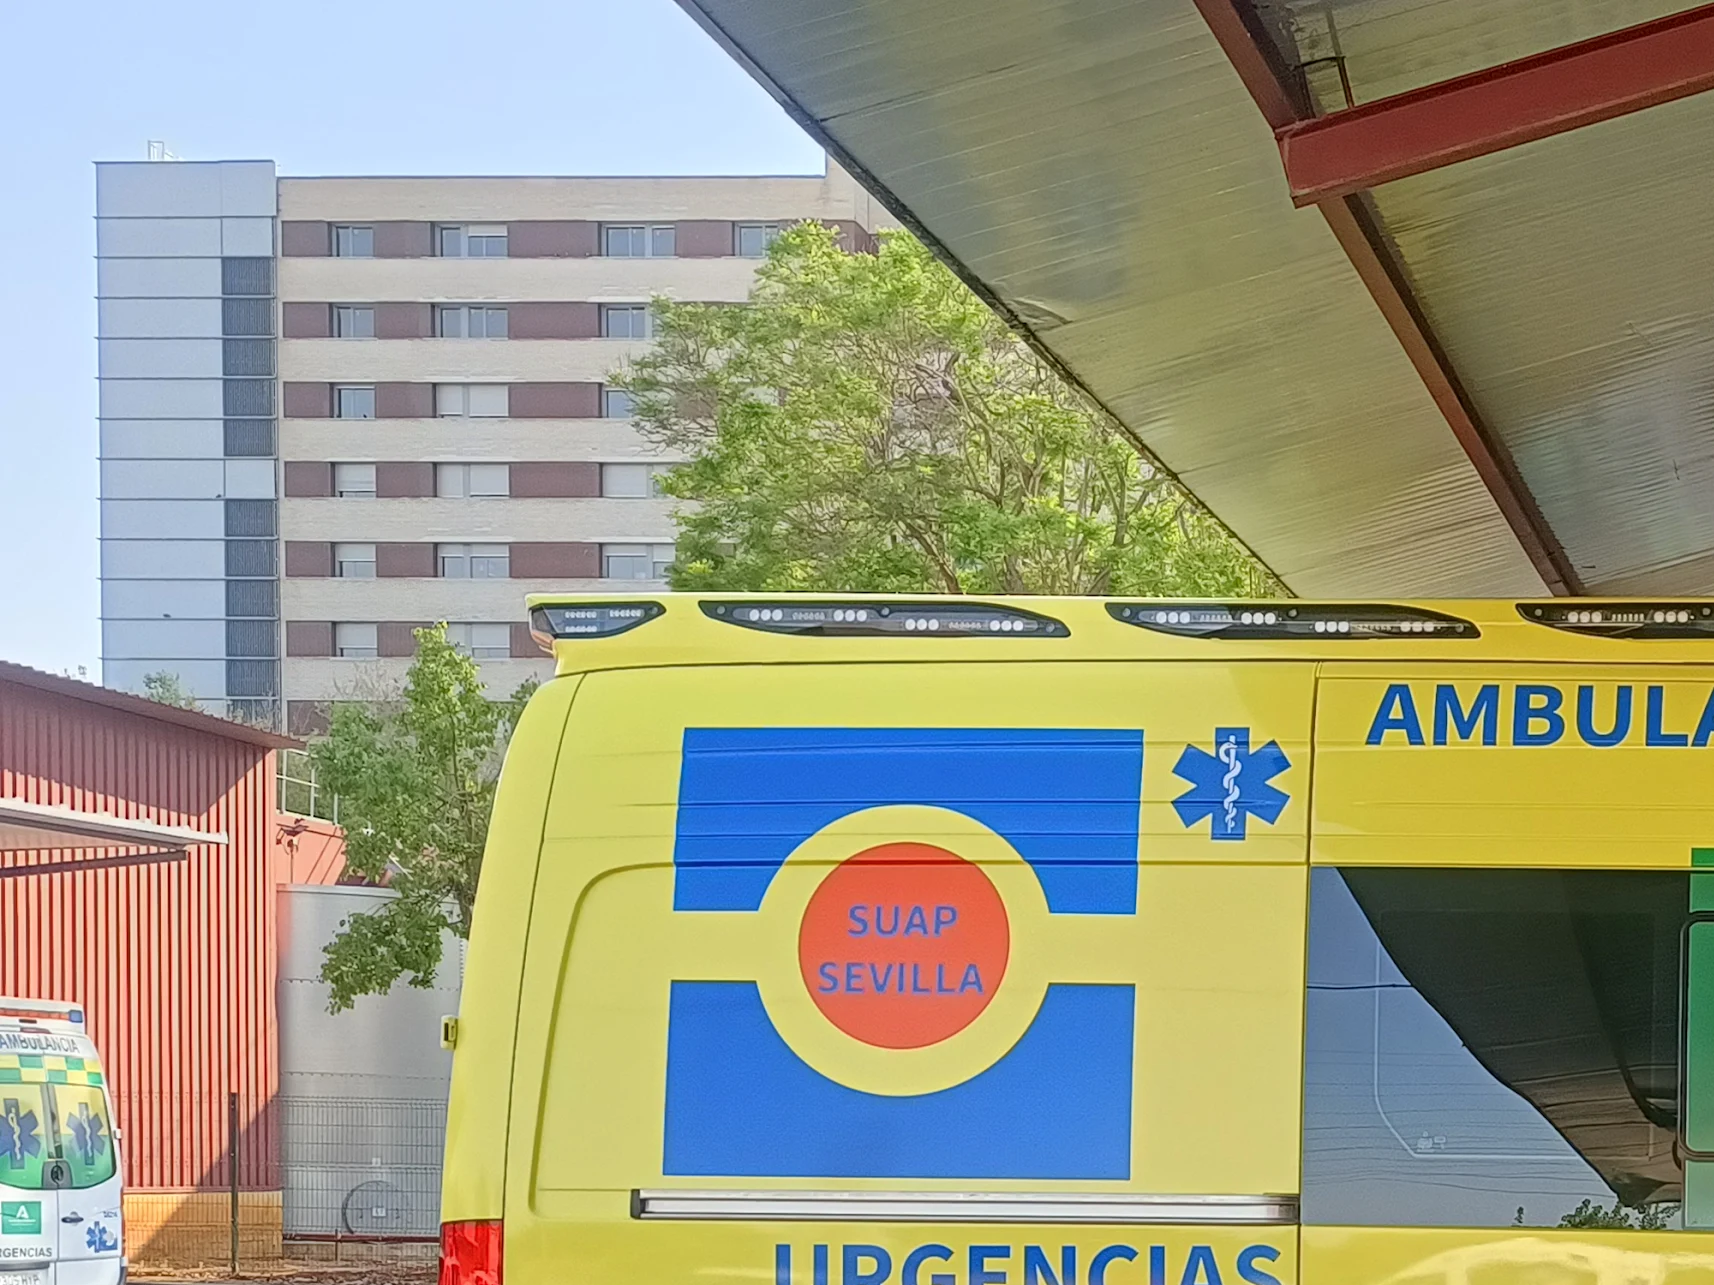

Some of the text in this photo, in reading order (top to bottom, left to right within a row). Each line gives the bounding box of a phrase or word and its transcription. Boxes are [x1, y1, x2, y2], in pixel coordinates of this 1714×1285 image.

[847, 904, 958, 937] SUAP
[818, 961, 984, 994] SEVILLA
[0, 1033, 80, 1053] AMBULANCIA
[0, 1247, 52, 1258] GENCIAS
